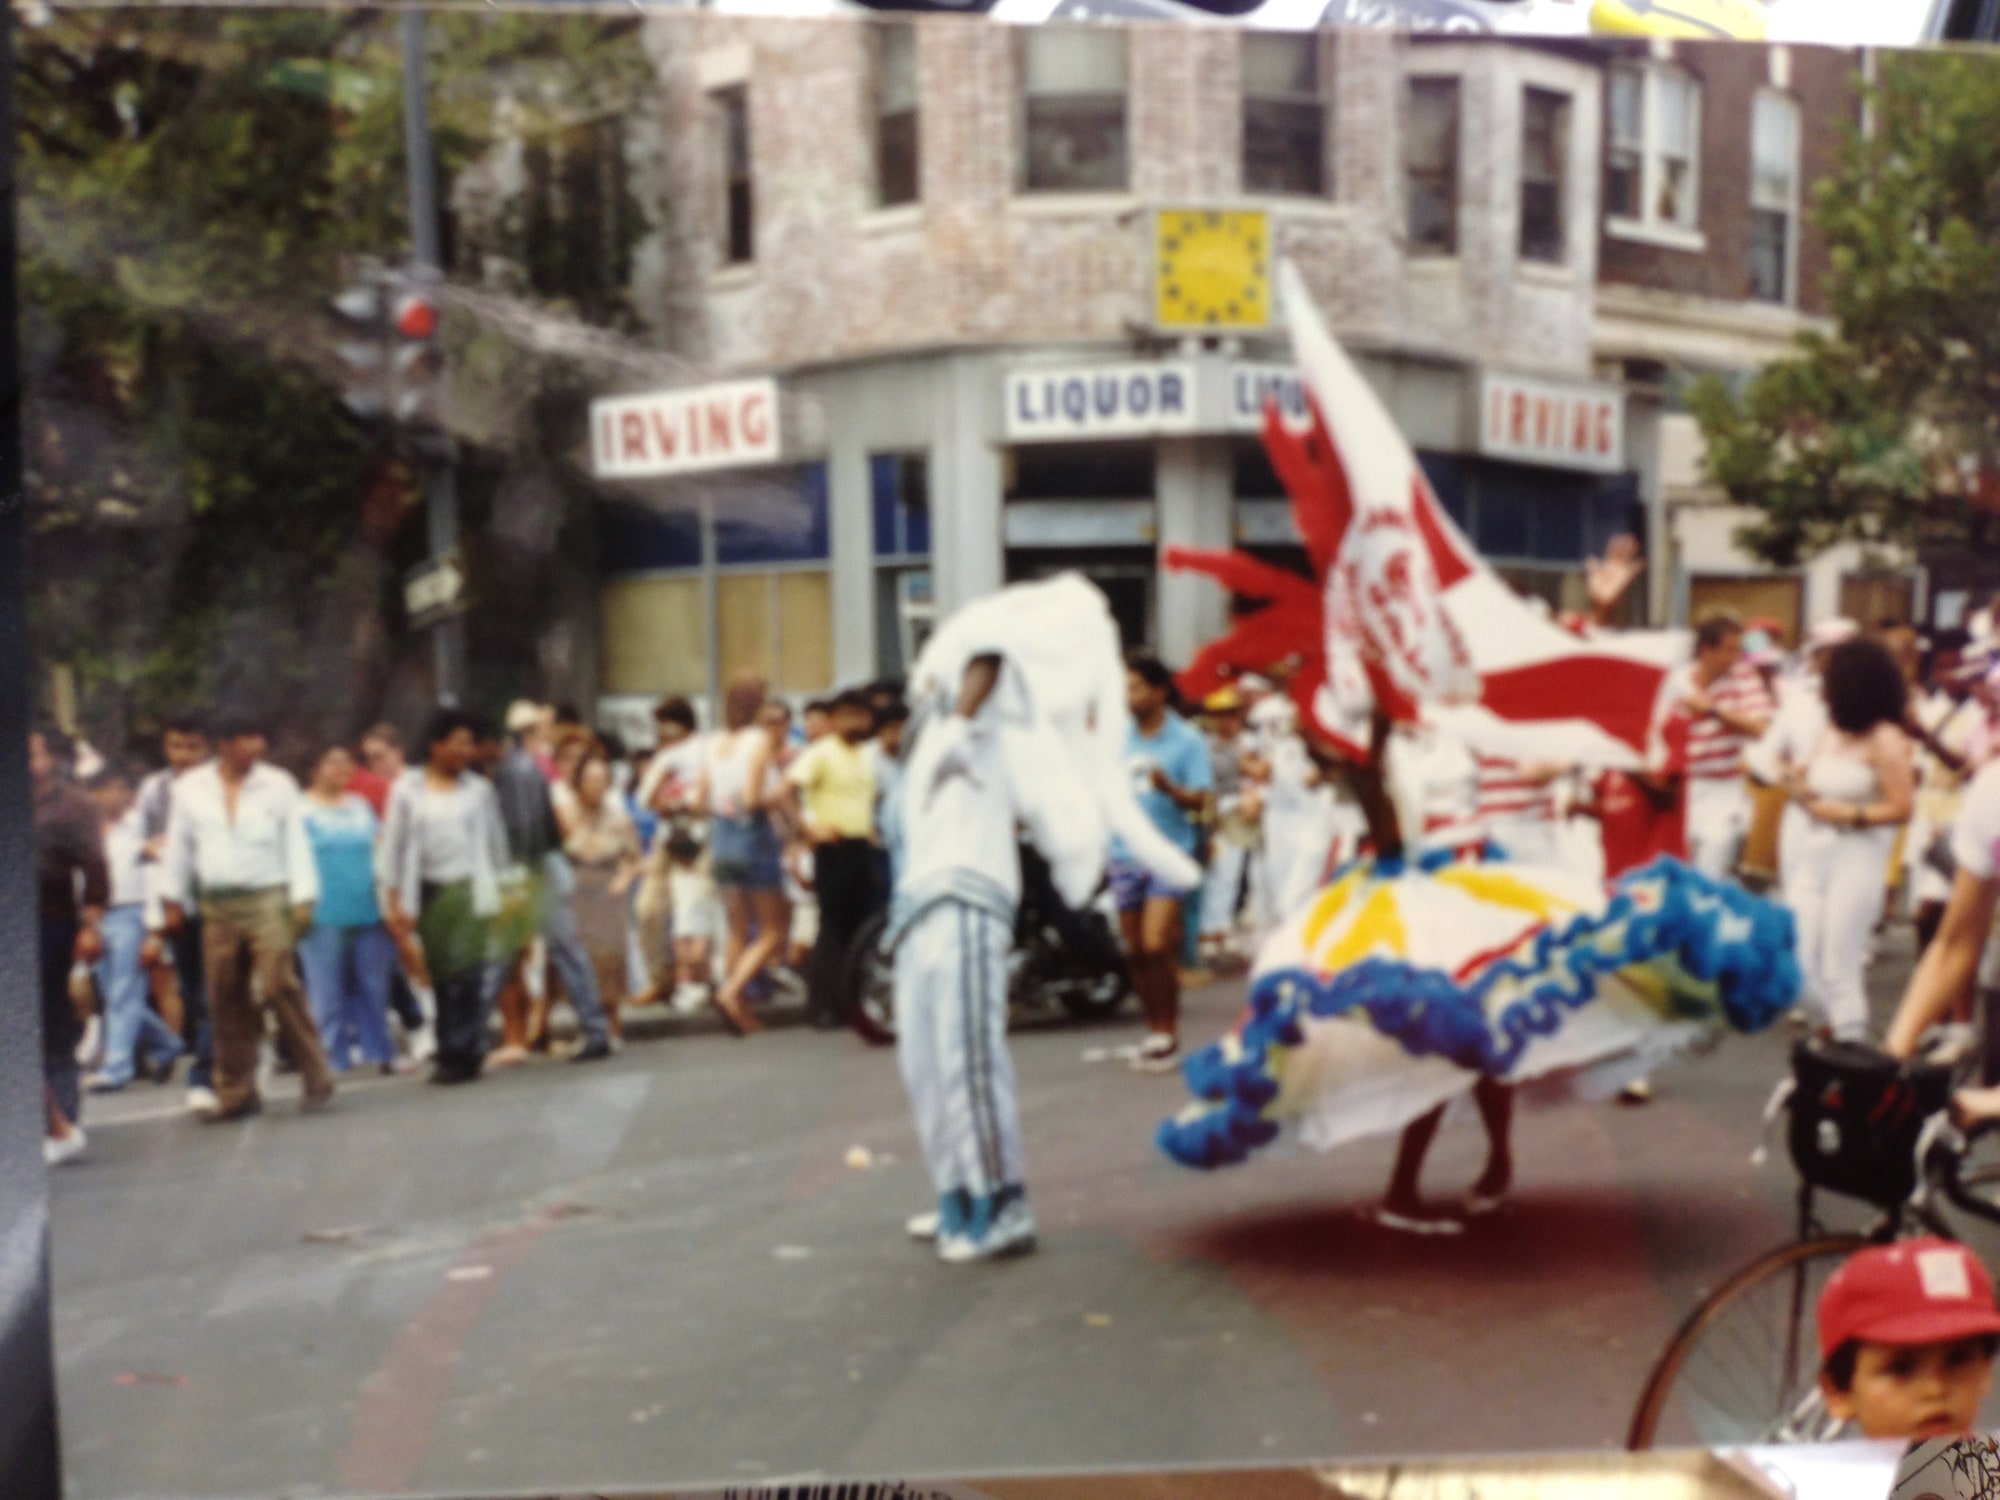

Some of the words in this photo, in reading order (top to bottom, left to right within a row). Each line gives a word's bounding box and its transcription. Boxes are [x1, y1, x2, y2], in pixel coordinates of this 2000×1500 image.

[602, 394, 768, 461] IRVING
[1017, 373, 1186, 425] LIQUOR
[1490, 386, 1613, 455] IRVING
